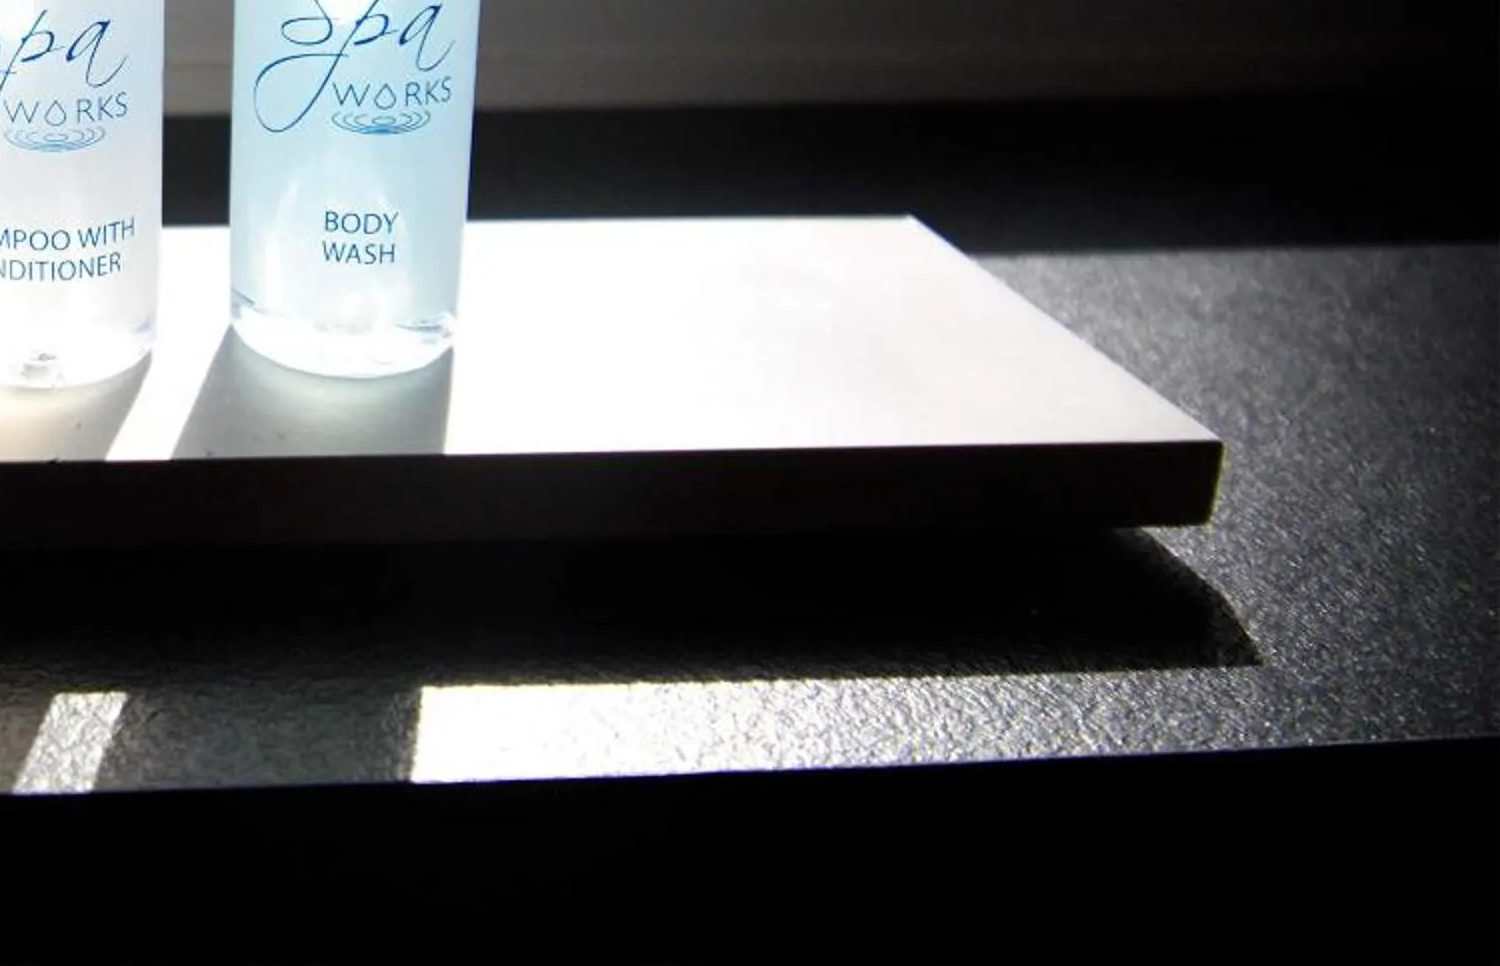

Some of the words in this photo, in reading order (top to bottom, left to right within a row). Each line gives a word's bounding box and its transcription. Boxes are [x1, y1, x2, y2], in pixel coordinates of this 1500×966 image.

[3, 91, 129, 127] WORKS
[332, 76, 452, 111] WORKS
[77, 216, 135, 248] WITH
[324, 210, 399, 235] BODY
[321, 240, 396, 265] WASH
